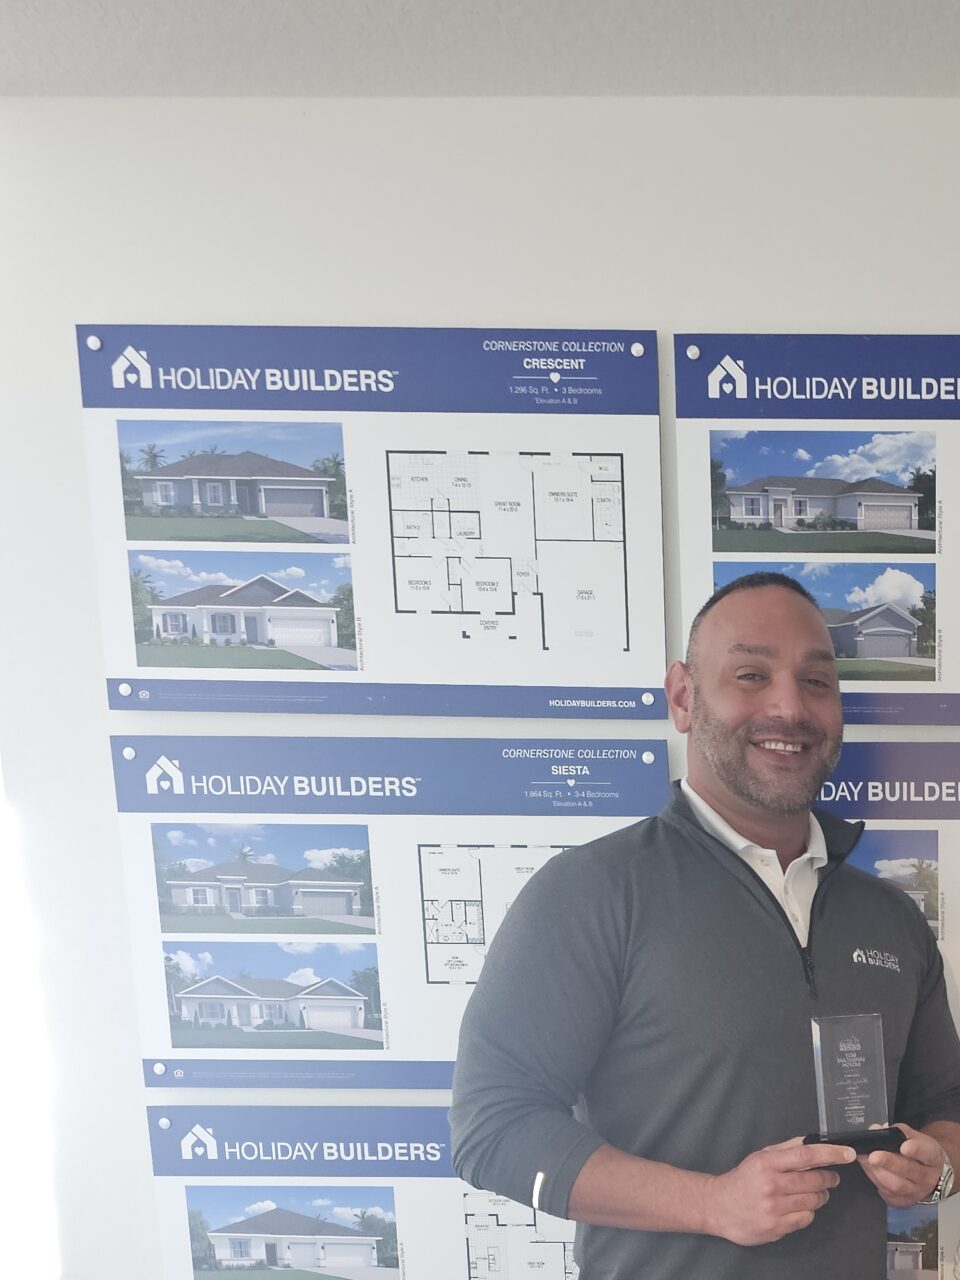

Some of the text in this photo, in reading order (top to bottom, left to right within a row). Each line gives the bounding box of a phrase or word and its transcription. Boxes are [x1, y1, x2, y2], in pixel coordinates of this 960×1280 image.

[483, 340, 625, 353] CORNERSTONE COLLECTION
[523, 358, 586, 370] CRESCENT
[158, 368, 395, 392] HOLIDAY BUILDERS
[568, 388, 602, 396] Bedrooms
[755, 377, 857, 400] HOLIDAY
[549, 700, 636, 708] HOLIDAYBUILDERS.COM
[502, 749, 637, 760] CORNERSTONE COLLECTION
[552, 766, 590, 776] SIESTA
[191, 775, 417, 797] HOLIDAY BUILDERS
[586, 791, 619, 799] Bedrooms
[867, 950, 898, 963] HOLIDAY
[868, 958, 900, 972] BUILDERS
[224, 1142, 441, 1161] HOLIDAY BUILDERS
